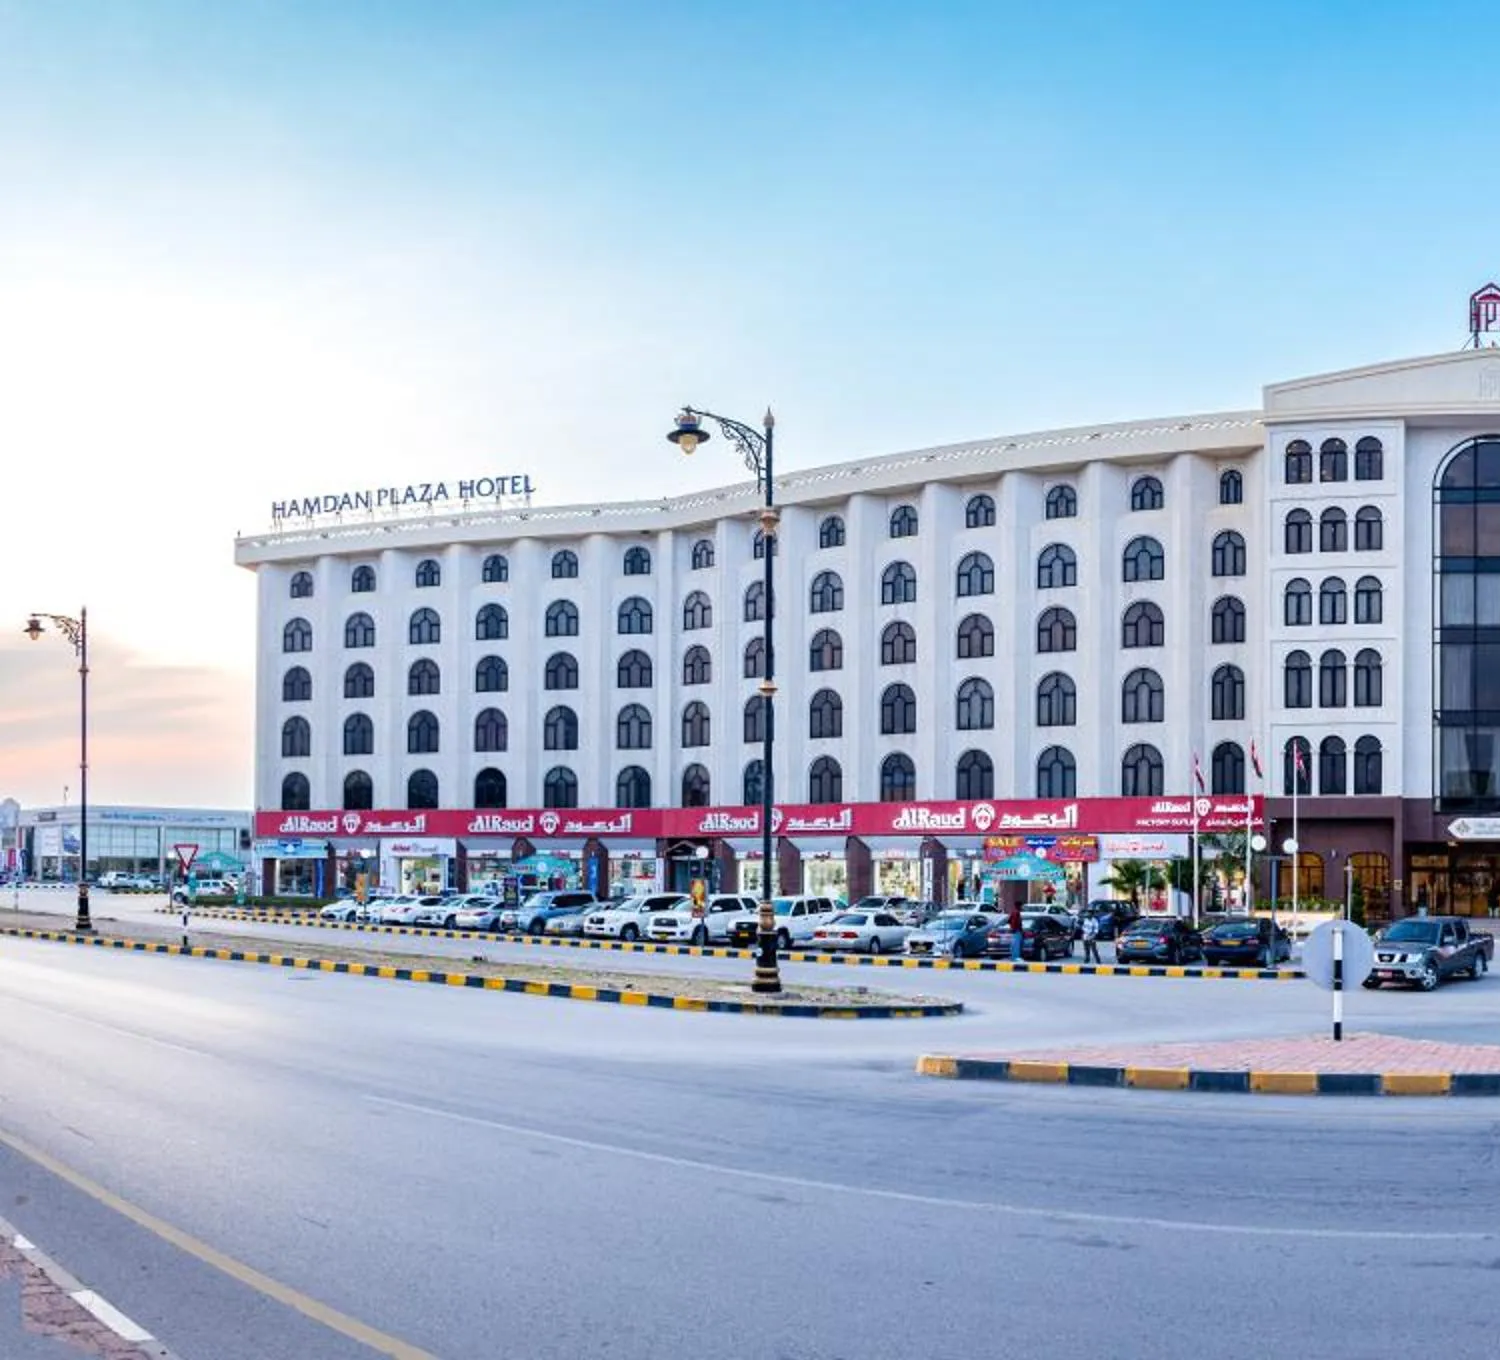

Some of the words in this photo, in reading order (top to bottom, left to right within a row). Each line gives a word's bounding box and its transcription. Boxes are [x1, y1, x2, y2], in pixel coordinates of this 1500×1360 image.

[271, 490, 372, 519] HAMDAN
[377, 482, 449, 507] PLAZA
[459, 474, 536, 499] HOTEL
